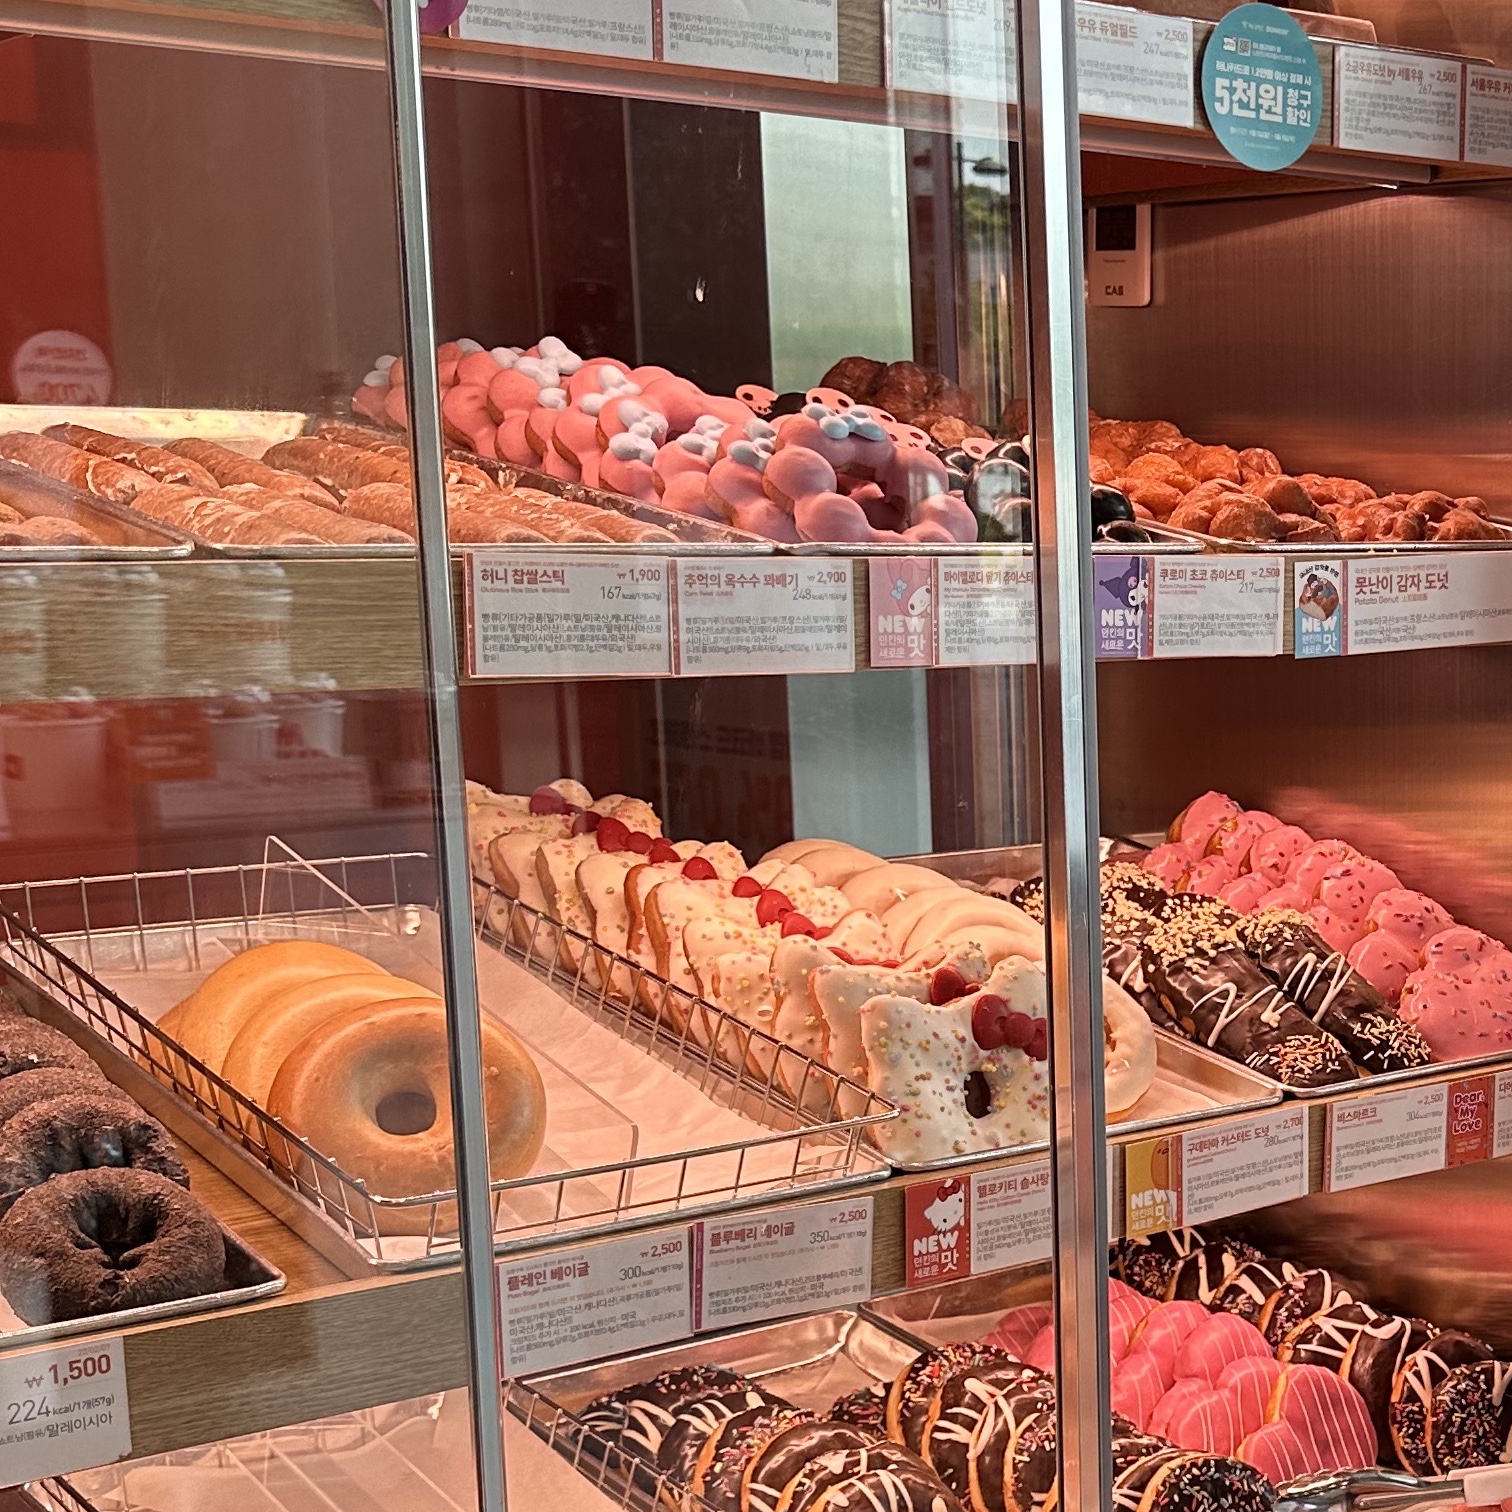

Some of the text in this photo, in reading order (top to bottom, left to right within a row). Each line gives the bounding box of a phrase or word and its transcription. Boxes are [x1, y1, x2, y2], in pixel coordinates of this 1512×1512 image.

[1304, 75, 1311, 86] 시
[1387, 67, 1396, 80] by
[1436, 70, 1457, 83] 2,500
[1470, 77, 1501, 92] 서울우유
[1214, 77, 1284, 123] 5천원
[1287, 88, 1312, 108] 청구
[1286, 106, 1311, 128] 할인
[480, 568, 565, 585] 허니 찹쌀스틱
[629, 568, 661, 583] 1,900
[684, 573, 721, 588] 추억의
[724, 573, 760, 588] 옥수수
[817, 571, 846, 585] 2,900
[943, 570, 984, 585] 마이멜로디
[1159, 568, 1245, 582] 쿠로미 초코 츄이스티
[1259, 568, 1280, 579] 2,500
[1239, 582, 1254, 593] 217
[1355, 571, 1449, 596] 못난이 감자 도넛
[601, 585, 621, 600] 167
[792, 588, 812, 600] 248
[878, 615, 926, 633] NEW
[1101, 608, 1143, 627] NEW
[1302, 616, 1337, 633] NEW
[907, 635, 926, 658] 맛
[1458, 1105, 1476, 1121] My
[1220, 1132, 1253, 1147] 커스터드
[1254, 1125, 1270, 1137] 도넛
[1264, 1135, 1279, 1148] 280
[977, 1180, 1018, 1199] 헬로키티
[838, 1209, 867, 1224] 2,500
[710, 1228, 758, 1247] 블루베리
[809, 1230, 829, 1244] 350
[913, 1231, 959, 1257] NEW
[650, 1240, 683, 1258] 2,500
[941, 1249, 959, 1273] 맛
[507, 1271, 547, 1292] 플레인
[550, 1261, 590, 1282] 베이글
[619, 1265, 642, 1281] 300
[48, 1354, 111, 1386] 1,500
[7, 1396, 51, 1425] 224
